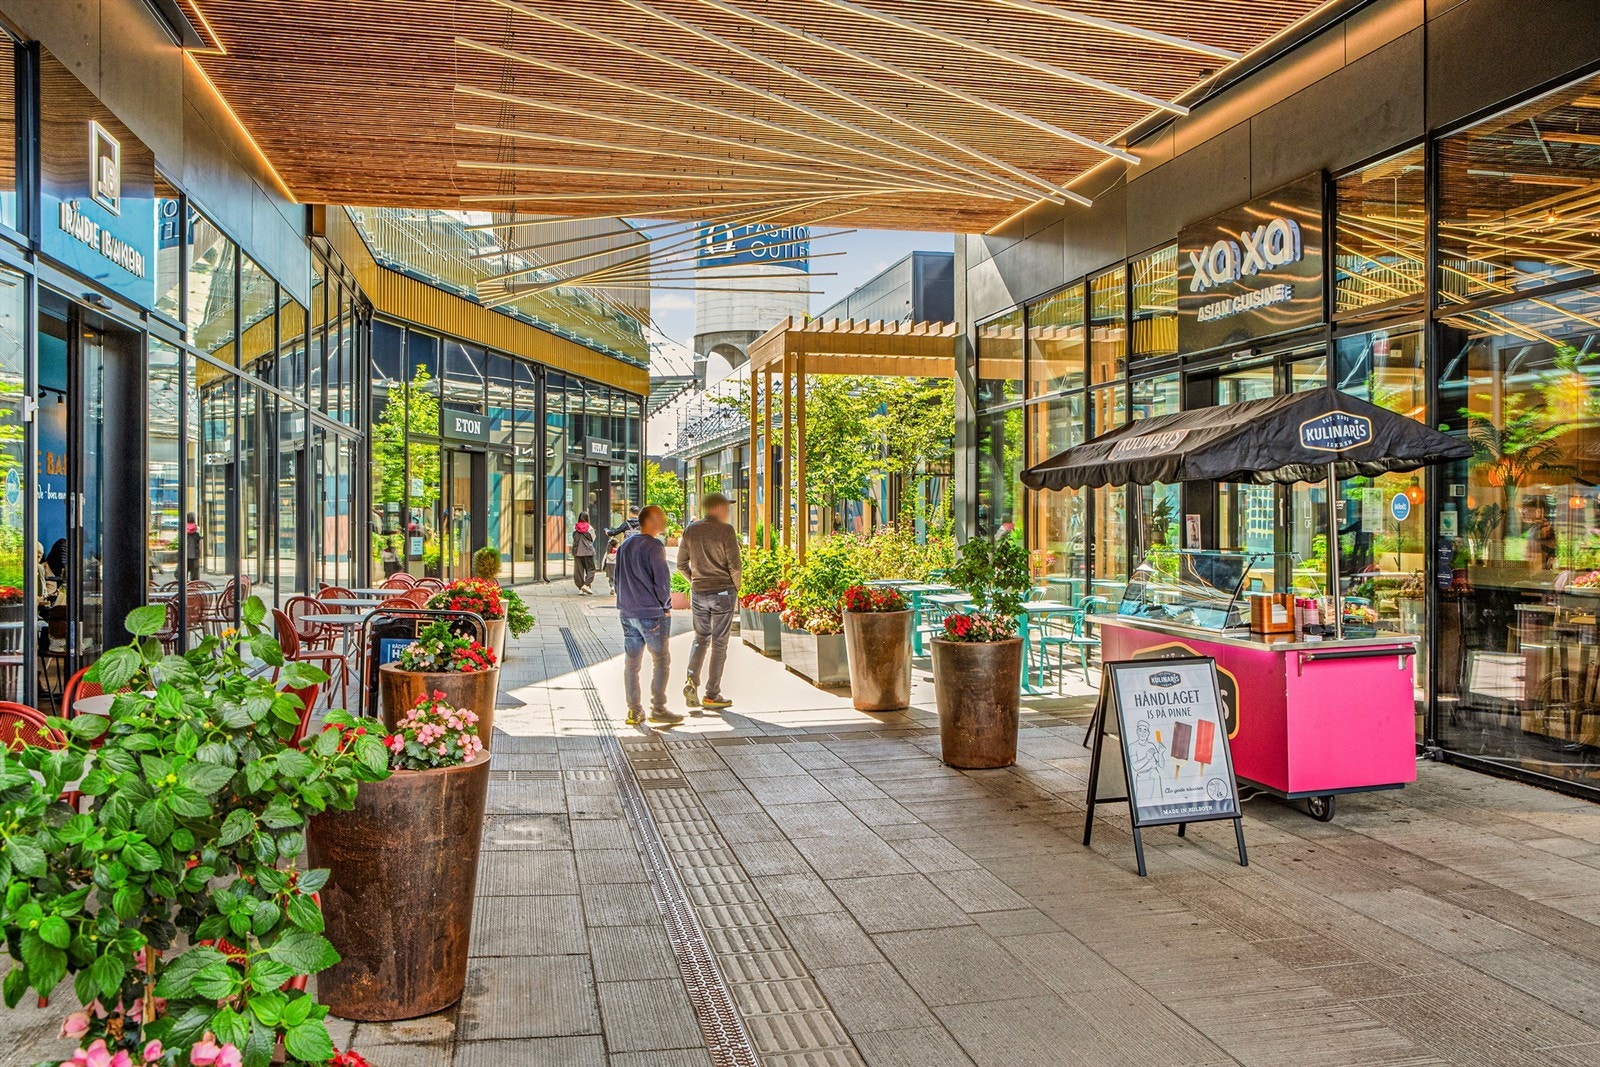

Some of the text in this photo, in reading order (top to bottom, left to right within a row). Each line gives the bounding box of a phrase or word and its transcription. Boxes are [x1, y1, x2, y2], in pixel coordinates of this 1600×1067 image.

[1197, 283, 1287, 322] ASIAN CUISINE
[455, 417, 481, 435] ETON
[1134, 689, 1200, 707] HÅNDLAGET
[1146, 706, 1192, 720] IS PÅ PINNE
